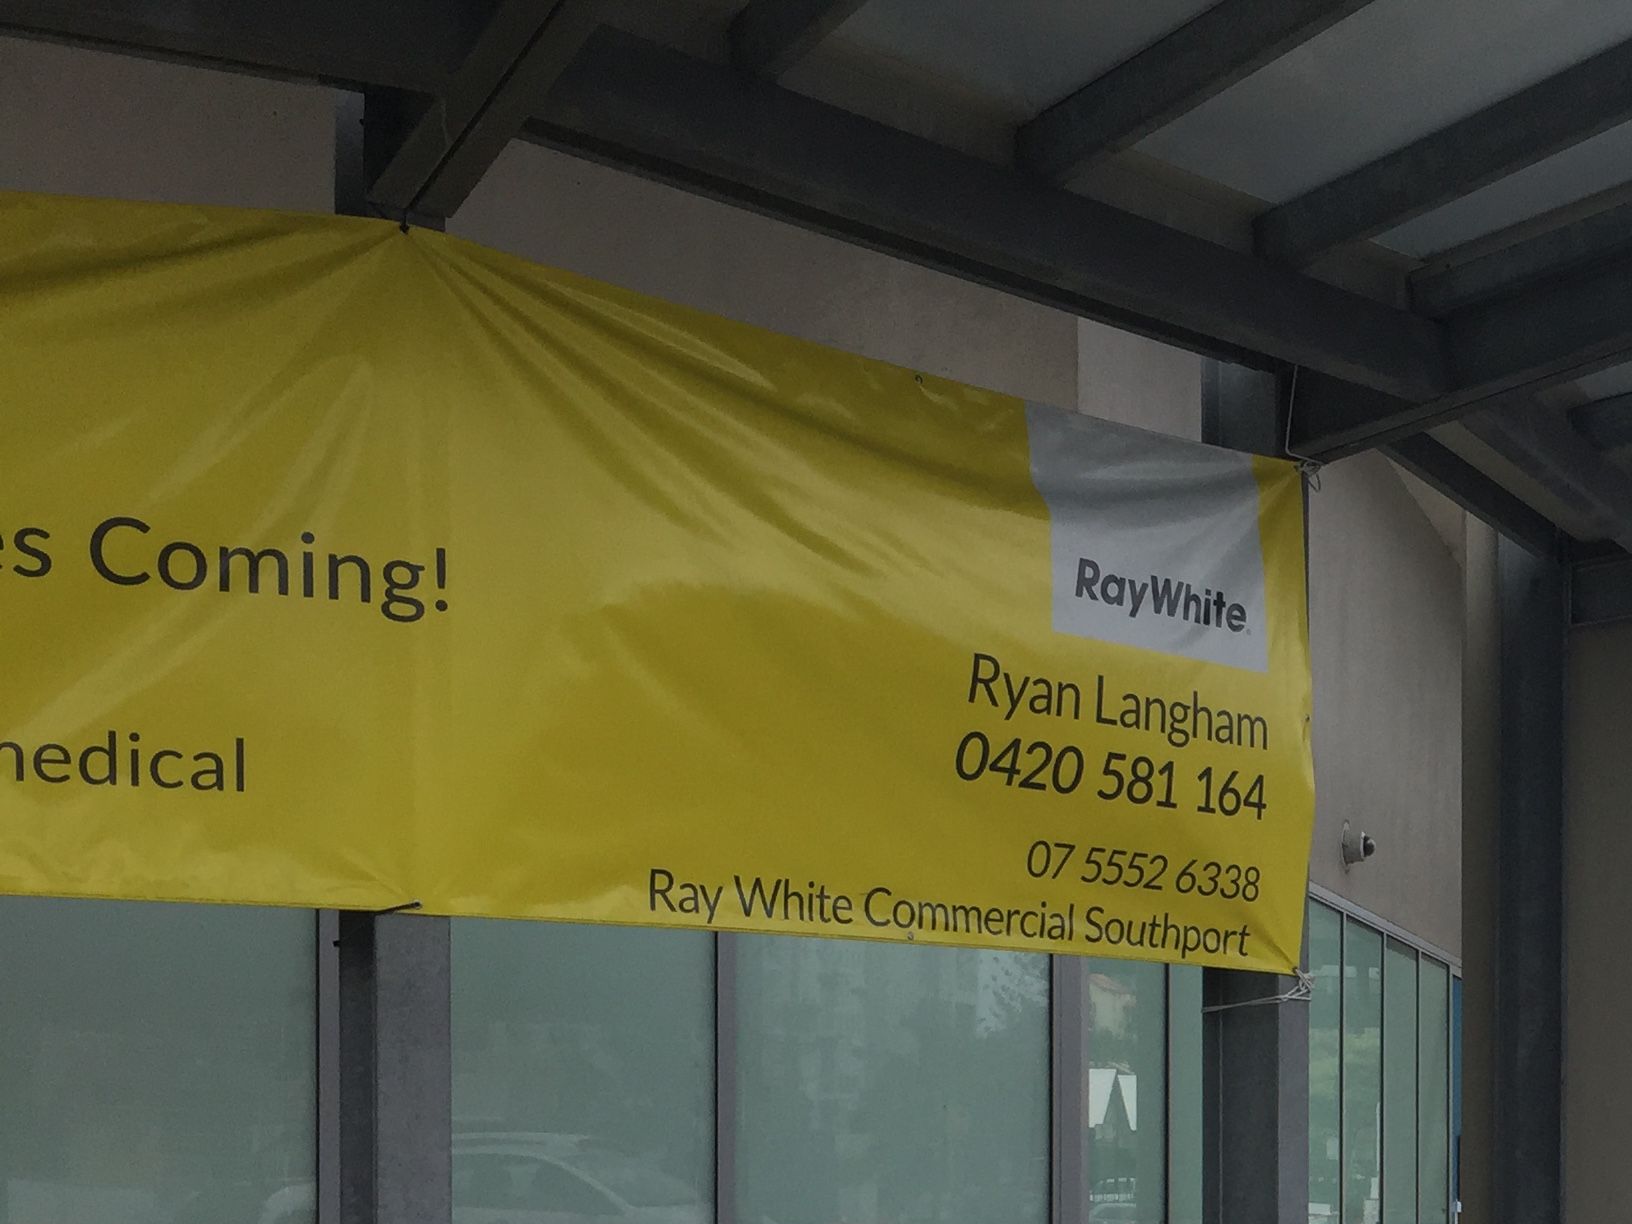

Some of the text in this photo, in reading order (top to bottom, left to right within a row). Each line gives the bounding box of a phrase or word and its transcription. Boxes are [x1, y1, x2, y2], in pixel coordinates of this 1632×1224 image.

[0, 516, 449, 622] s Coming!
[967, 652, 1268, 750] Ryan Langham
[954, 732, 1266, 820] 0420 581 164
[648, 868, 1251, 959] Ray White Commercial Southport
[1026, 839, 1260, 902] 07 5552 6338
